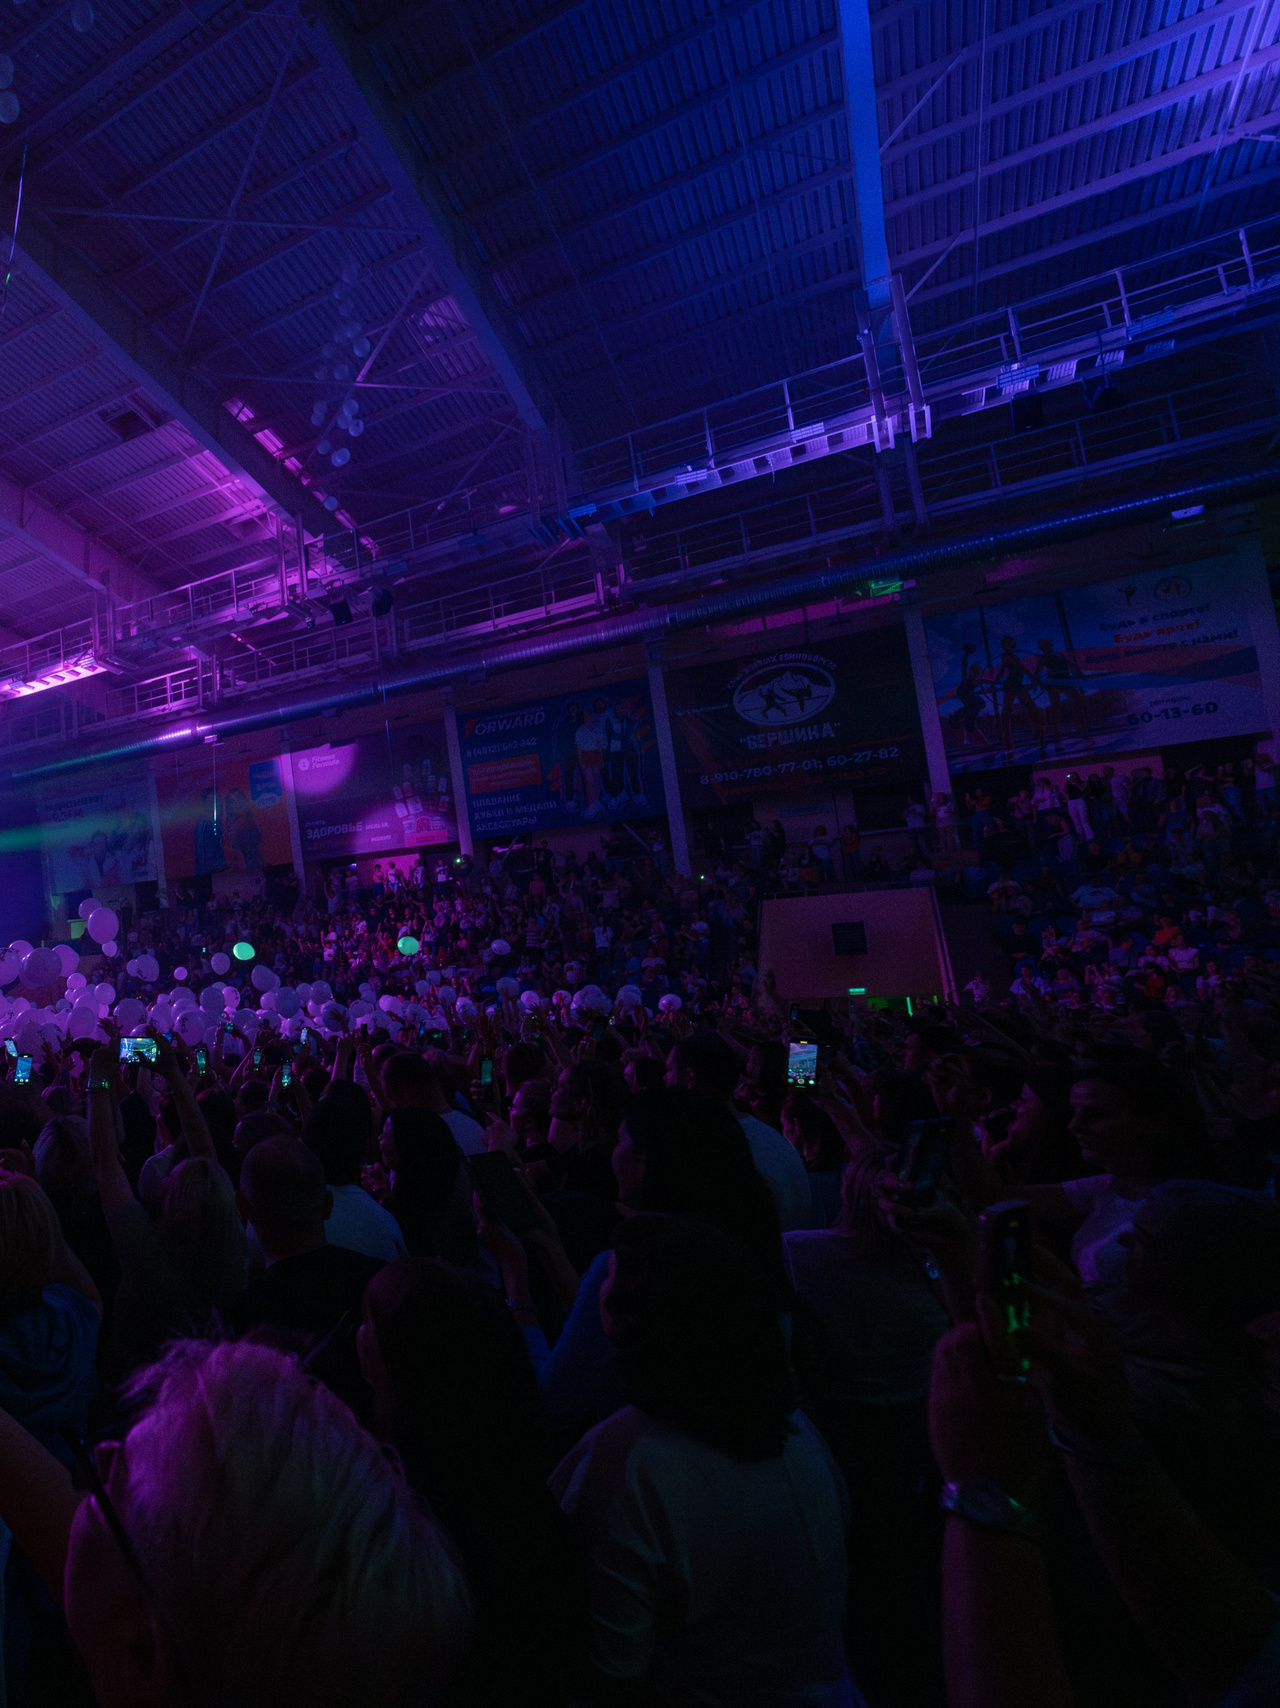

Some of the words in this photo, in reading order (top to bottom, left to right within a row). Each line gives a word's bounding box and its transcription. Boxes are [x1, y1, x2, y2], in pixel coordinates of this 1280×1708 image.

[1114, 632, 1151, 644] Будь
[1157, 620, 1200, 637] ярче!
[1192, 629, 1238, 646] нами!
[1127, 702, 1218, 726] 60-13-60
[739, 721, 841, 751] "ВЕРШИНА"
[699, 758, 823, 786] 8-910-780-77-01;
[827, 746, 899, 766] 60-27-82
[472, 793, 522, 809] ПЛАВАНИЕ
[474, 808, 505, 821] КУБКИ
[506, 807, 513, 816] И
[515, 800, 558, 815] МЕДАЛИ
[306, 821, 363, 840] ЗДОРОВЬЕ
[475, 816, 538, 832] АКСЕССУАРЫ
